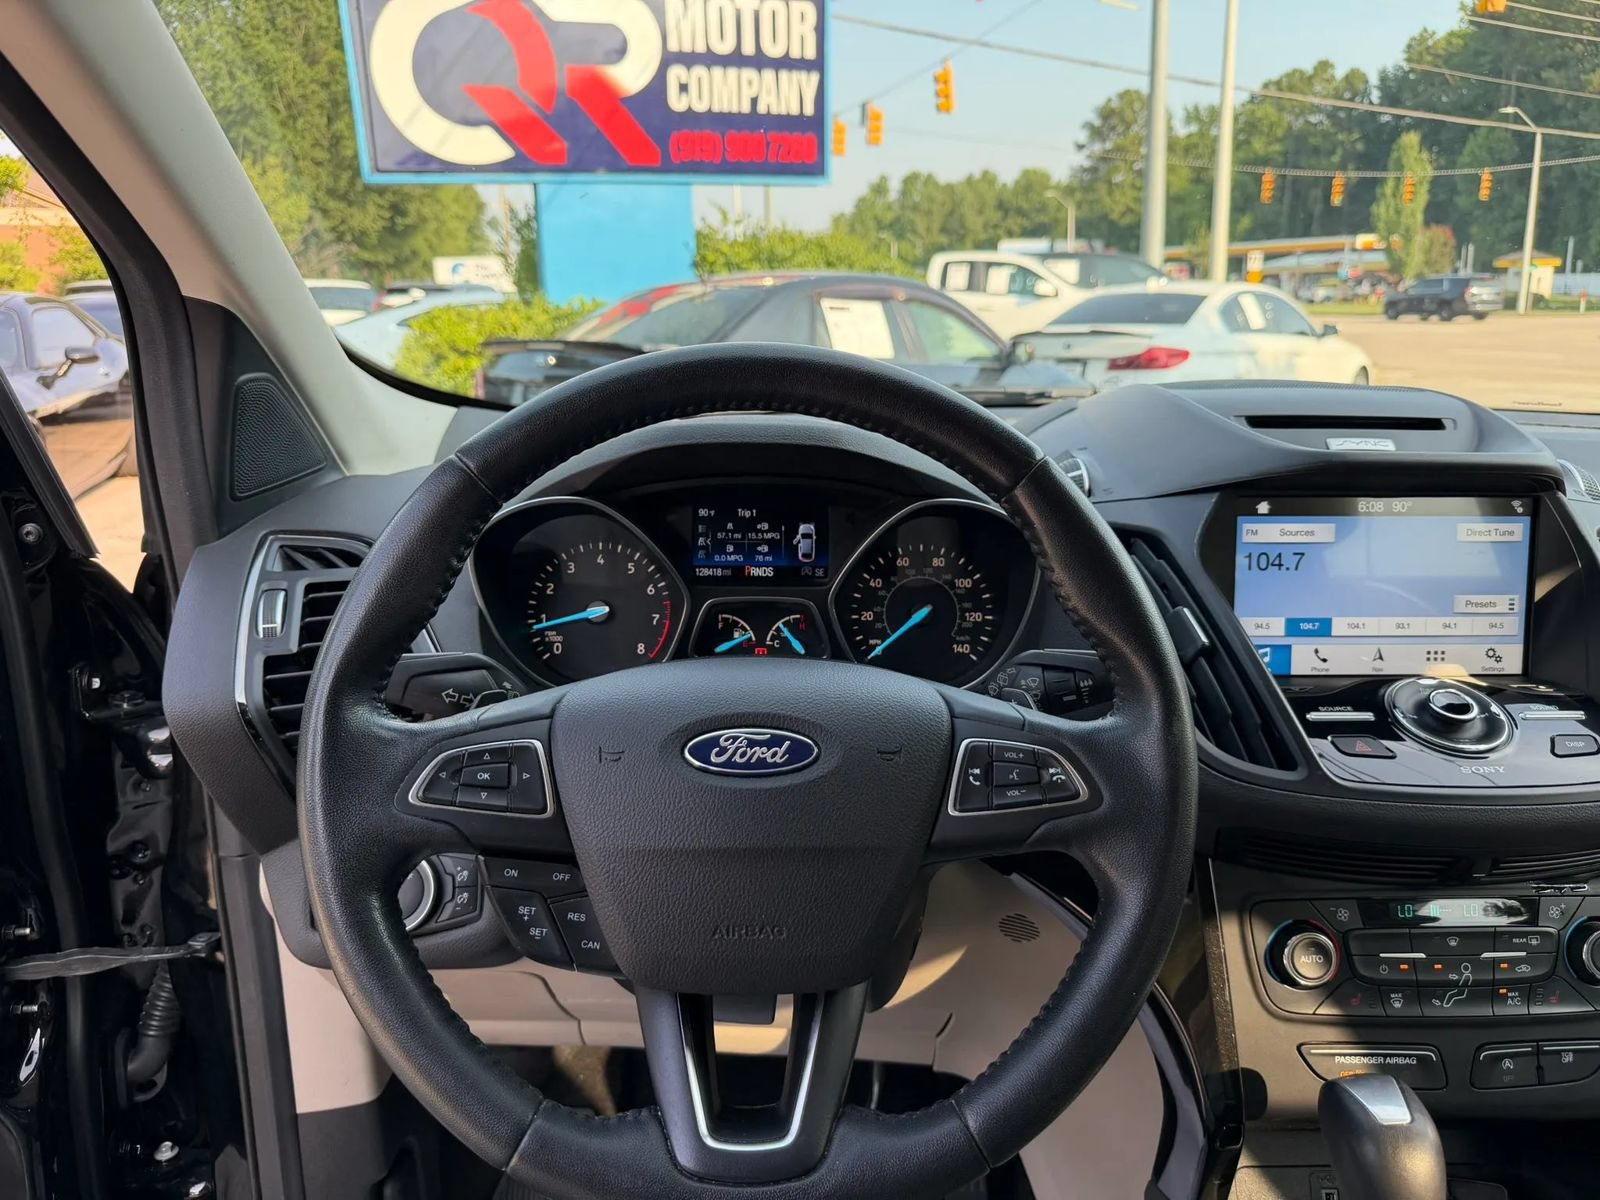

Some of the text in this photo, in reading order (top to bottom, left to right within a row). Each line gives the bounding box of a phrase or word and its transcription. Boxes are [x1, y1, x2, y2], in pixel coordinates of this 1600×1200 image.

[664, 0, 818, 60] MOTOR
[666, 64, 820, 116] COMPANY
[1358, 501, 1412, 512] 6:08 90°
[698, 509, 709, 517] 90
[737, 508, 757, 518] Trip 1
[763, 532, 780, 540] MPG
[1246, 528, 1259, 537] FM
[1279, 527, 1315, 538] Sources
[1466, 527, 1515, 538] Direct Tune
[597, 554, 605, 565] 4
[727, 554, 744, 562] MPG
[896, 557, 910, 567] 60
[932, 557, 945, 567] 80
[1243, 552, 1305, 571] 104.7
[567, 562, 576, 574] 3
[627, 562, 636, 574] 5
[695, 568, 722, 577] 128418
[869, 578, 882, 588] 40
[954, 578, 972, 588] 100
[546, 583, 555, 595] 2
[647, 583, 656, 595] 6
[1465, 599, 1497, 609] Presets
[652, 614, 660, 625] 7
[861, 611, 874, 621] 20
[964, 612, 983, 622] 120
[1254, 621, 1271, 630] 94.5
[1299, 621, 1320, 630] 104.7
[1347, 621, 1366, 630] 104.1
[1395, 621, 1411, 630] 93.1
[1442, 621, 1457, 630] 94.1
[1488, 621, 1504, 630] 94.5
[553, 642, 562, 655] 0
[637, 643, 645, 654] 8
[774, 640, 780, 648] C
[952, 644, 970, 654] 140
[710, 733, 790, 764] Ford
[1460, 765, 1505, 774] SONY
[477, 772, 490, 781] OK
[504, 868, 518, 878] ON
[552, 872, 571, 882] OFF
[518, 906, 536, 915] SET
[567, 912, 586, 922] RES
[529, 928, 548, 937] SET
[710, 926, 788, 941] AIRBAG
[581, 940, 600, 950] CAN
[1300, 954, 1323, 964] AUTO
[1507, 998, 1521, 1006] A/C
[1335, 1056, 1417, 1064] PASSENGER AIRBAG
